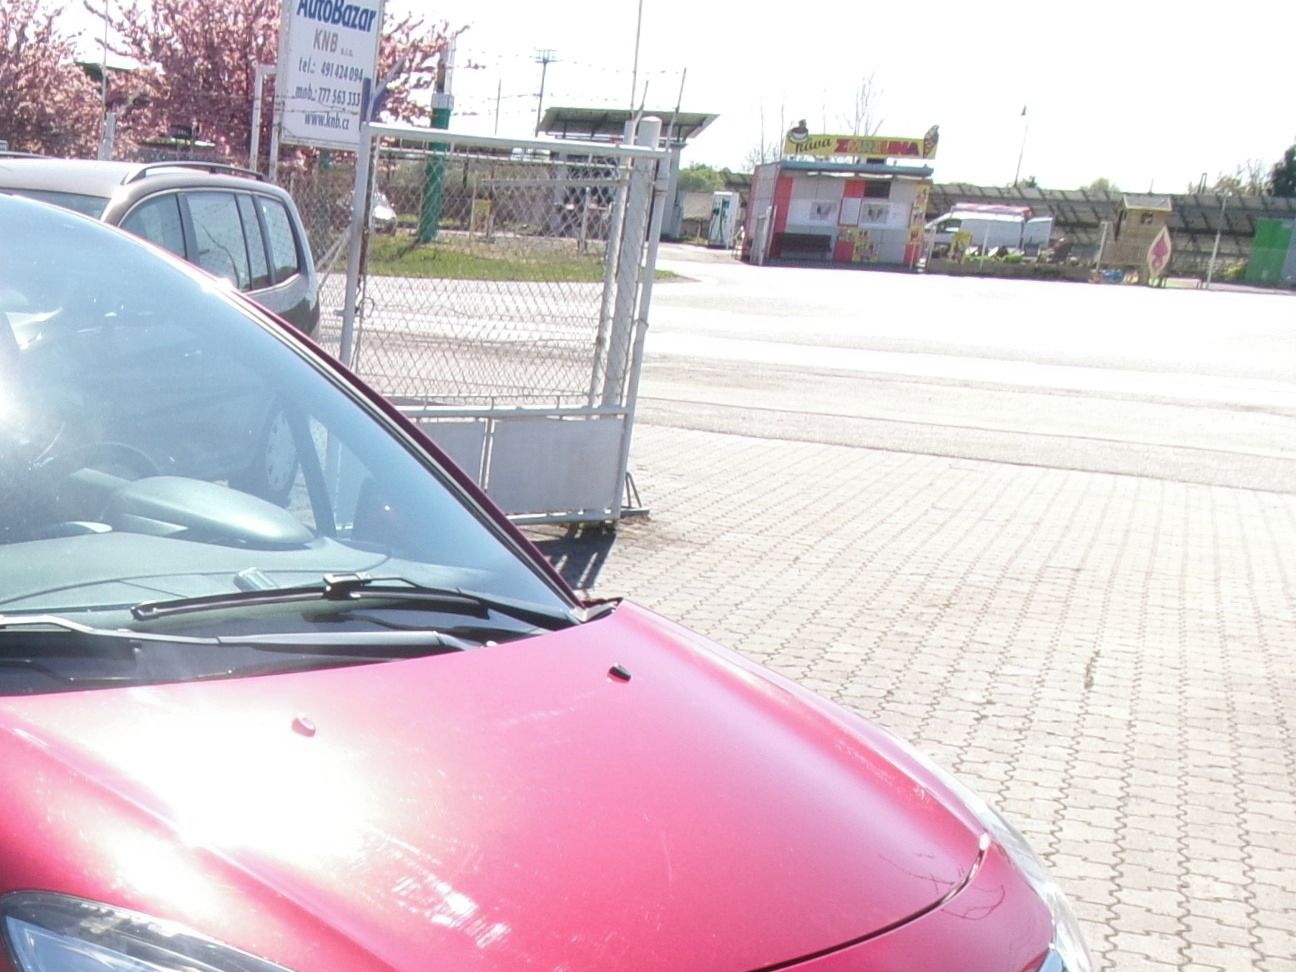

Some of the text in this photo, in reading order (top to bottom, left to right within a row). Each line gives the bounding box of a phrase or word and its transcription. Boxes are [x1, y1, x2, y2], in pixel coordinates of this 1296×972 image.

[296, 0, 377, 32] AutoBazar
[313, 27, 339, 53] KNB
[321, 61, 335, 78] 491
[335, 63, 349, 80] 424
[349, 66, 364, 82] 094
[318, 87, 331, 103] 777
[332, 89, 346, 105] 563
[347, 91, 361, 107] 333
[304, 112, 349, 130] www.knb.cz
